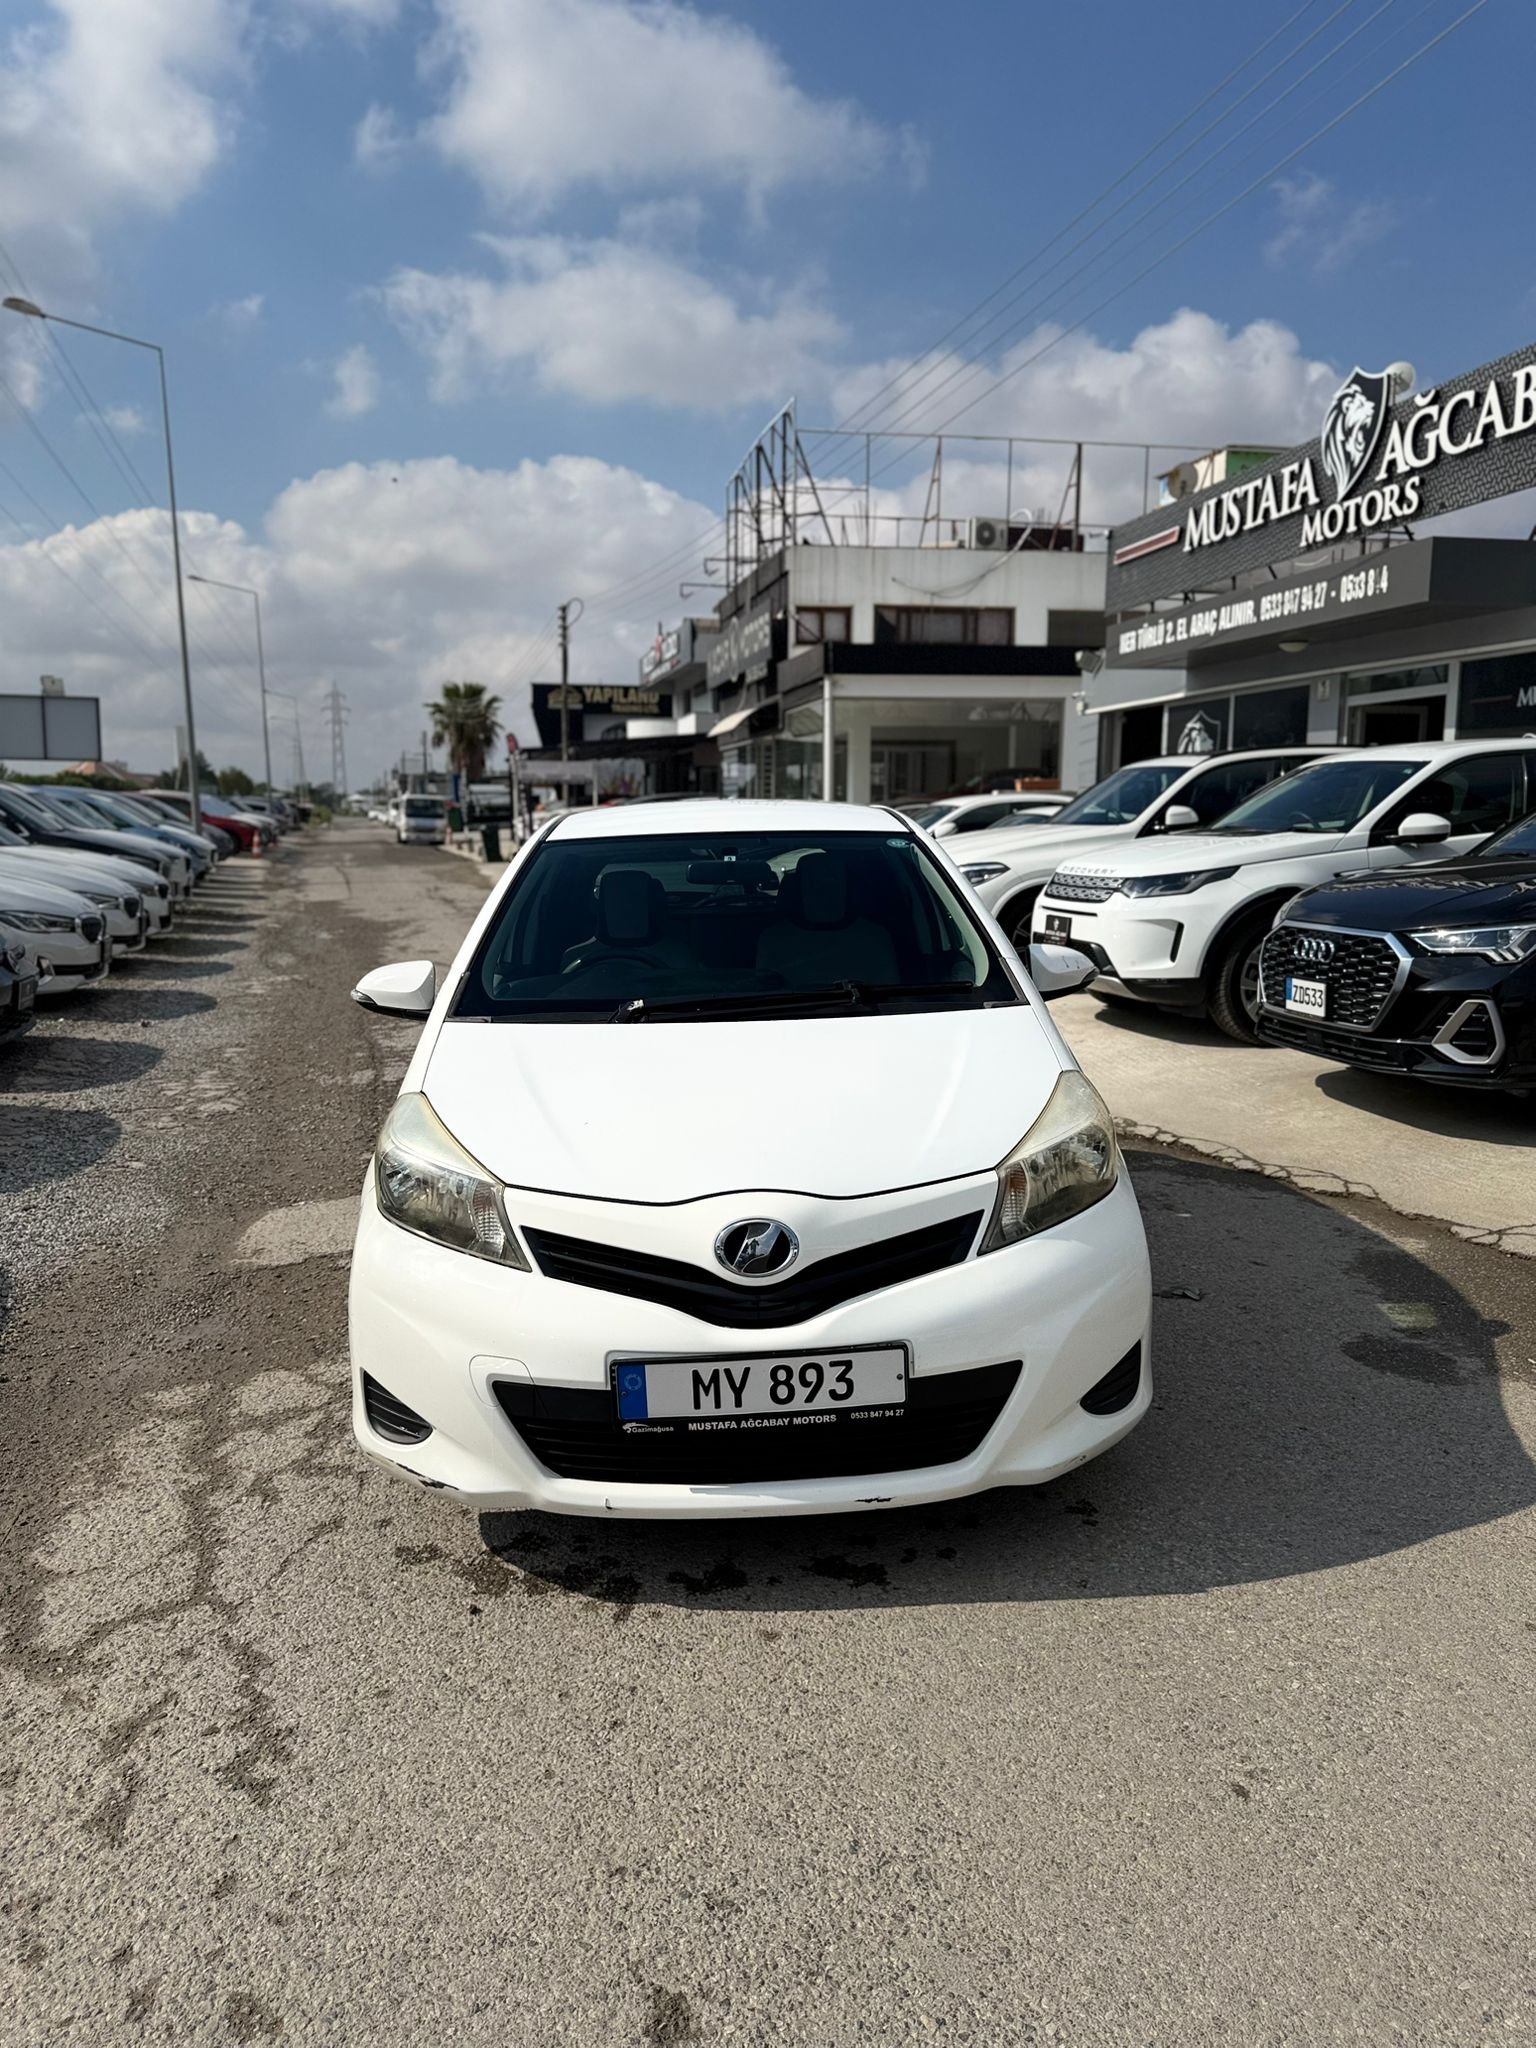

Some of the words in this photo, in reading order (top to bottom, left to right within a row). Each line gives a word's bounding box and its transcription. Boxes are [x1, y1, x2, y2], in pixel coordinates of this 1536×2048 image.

[1183, 457, 1320, 552] MUSTAFA
[1299, 475, 1420, 547] MOTORS
[1190, 609, 1217, 636] ARAÇ
[1314, 581, 1327, 609] 27
[1293, 984, 1323, 1008] ZD533
[692, 1367, 750, 1410] MY
[769, 1359, 854, 1405] 893
[688, 1421, 737, 1431] MUSTAFA
[740, 1418, 790, 1428] AĞCABAY
[793, 1414, 837, 1425] MOTORS
[850, 1411, 868, 1419] 0533
[869, 1410, 883, 1418] 847
[884, 1409, 894, 1417] 94
